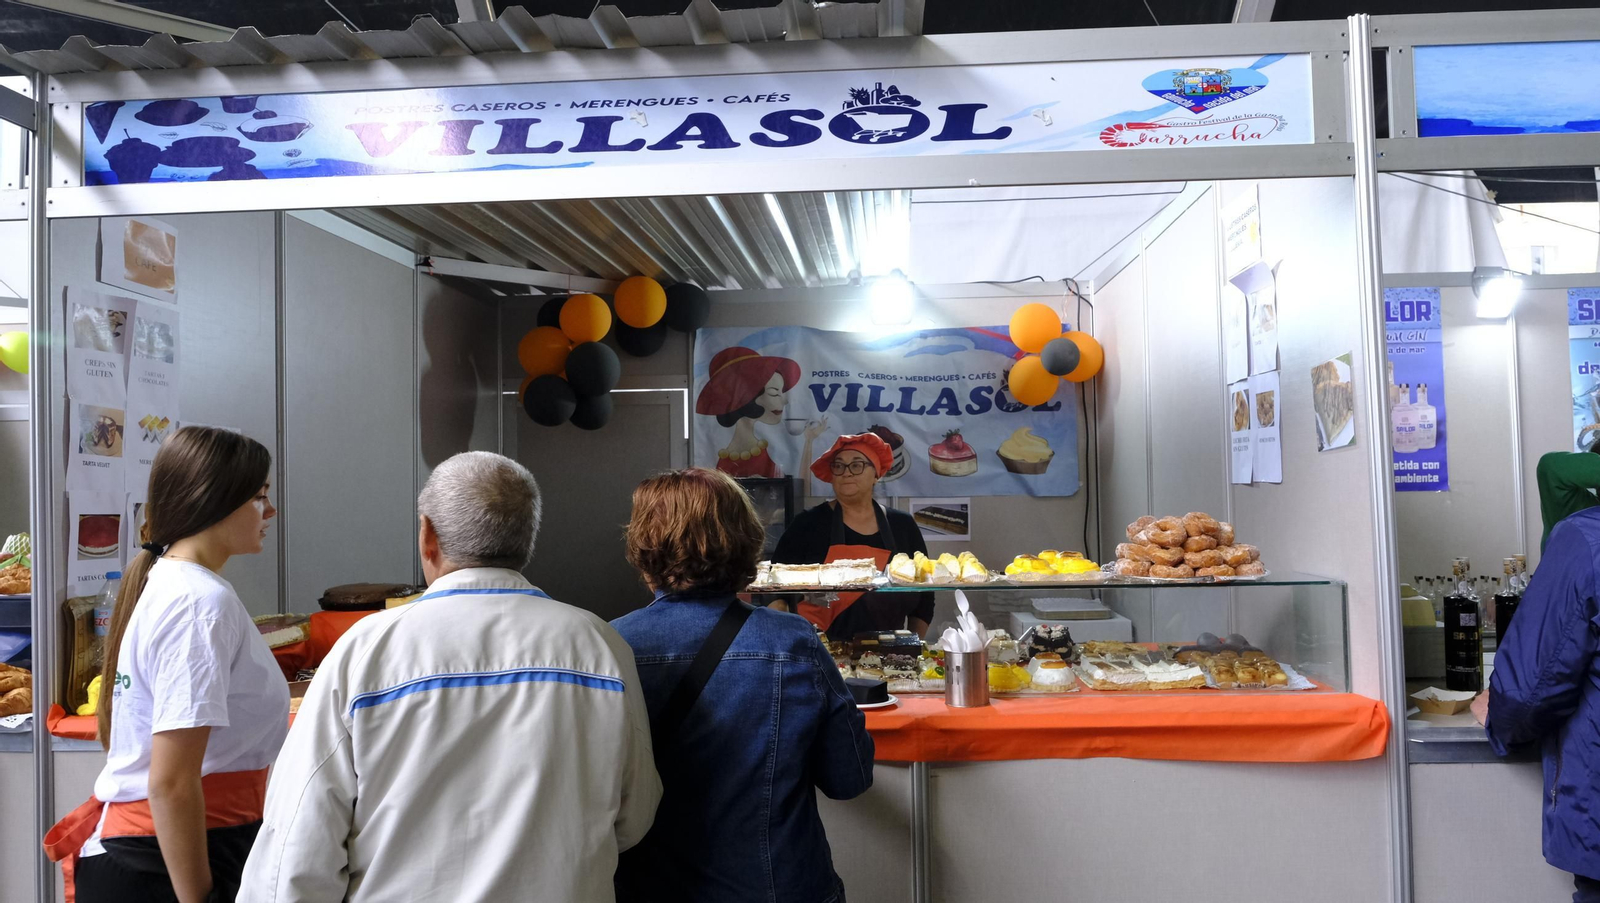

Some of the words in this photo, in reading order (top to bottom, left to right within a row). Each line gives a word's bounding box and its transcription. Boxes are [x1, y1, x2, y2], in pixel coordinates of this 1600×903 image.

[450, 101, 547, 113] CASEROS
[569, 96, 700, 110] MERENGUES
[722, 91, 791, 104] CAFÉS
[1198, 115, 1231, 125] Festival
[345, 103, 1013, 158] VILLASOL
[1385, 300, 1432, 322] LOR
[1406, 328, 1429, 341] GIN
[1395, 346, 1407, 354] de
[1408, 346, 1426, 354] mar
[86, 368, 114, 378] GLUTEN
[811, 370, 850, 378] POSTRES
[857, 371, 898, 381] CASEROS
[905, 373, 960, 383] MERENGUES
[968, 370, 997, 380] CAFÉS
[1393, 460, 1419, 470] etida
[1421, 461, 1440, 470] con
[1394, 472, 1440, 483] ambiente
[77, 575, 97, 583] TARTAS
